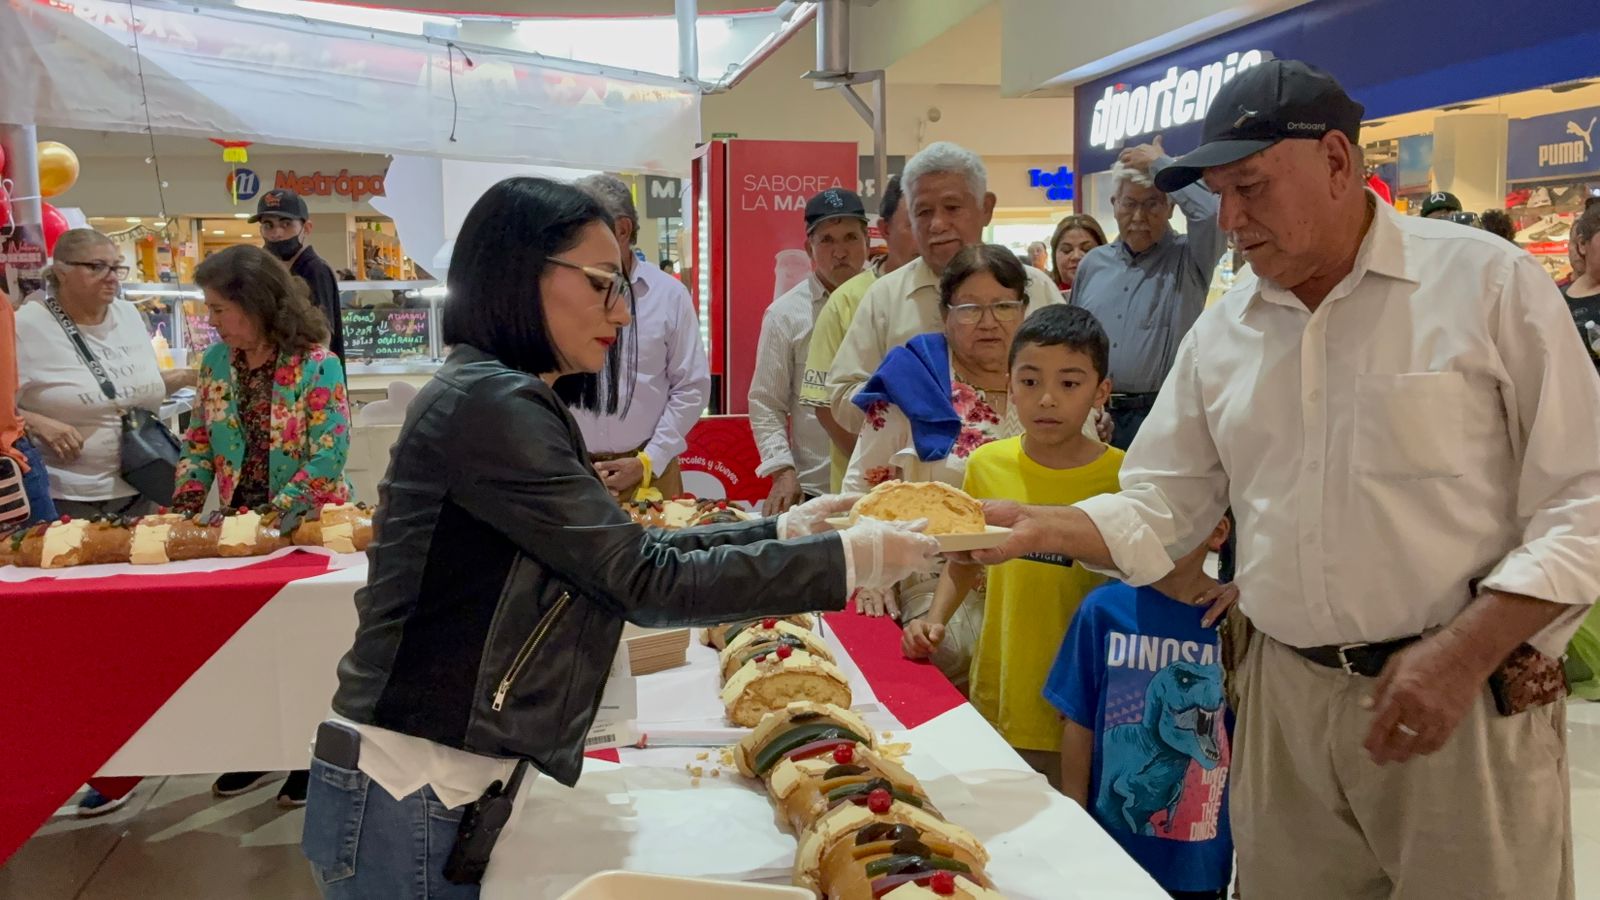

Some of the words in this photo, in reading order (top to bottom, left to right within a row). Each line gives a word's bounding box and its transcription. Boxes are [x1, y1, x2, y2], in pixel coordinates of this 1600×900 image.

[1287, 121, 1326, 130] Onboard
[1538, 140, 1585, 167] PUMA
[274, 169, 387, 201] Metrópo
[743, 174, 843, 192] SABOREA
[741, 195, 768, 211] LA
[773, 195, 807, 211] MA
[50, 300, 78, 336] COACH
[707, 460, 714, 471] y
[714, 461, 739, 485] Jueves
[1208, 784, 1224, 803] OF
[1202, 802, 1221, 822] THE
